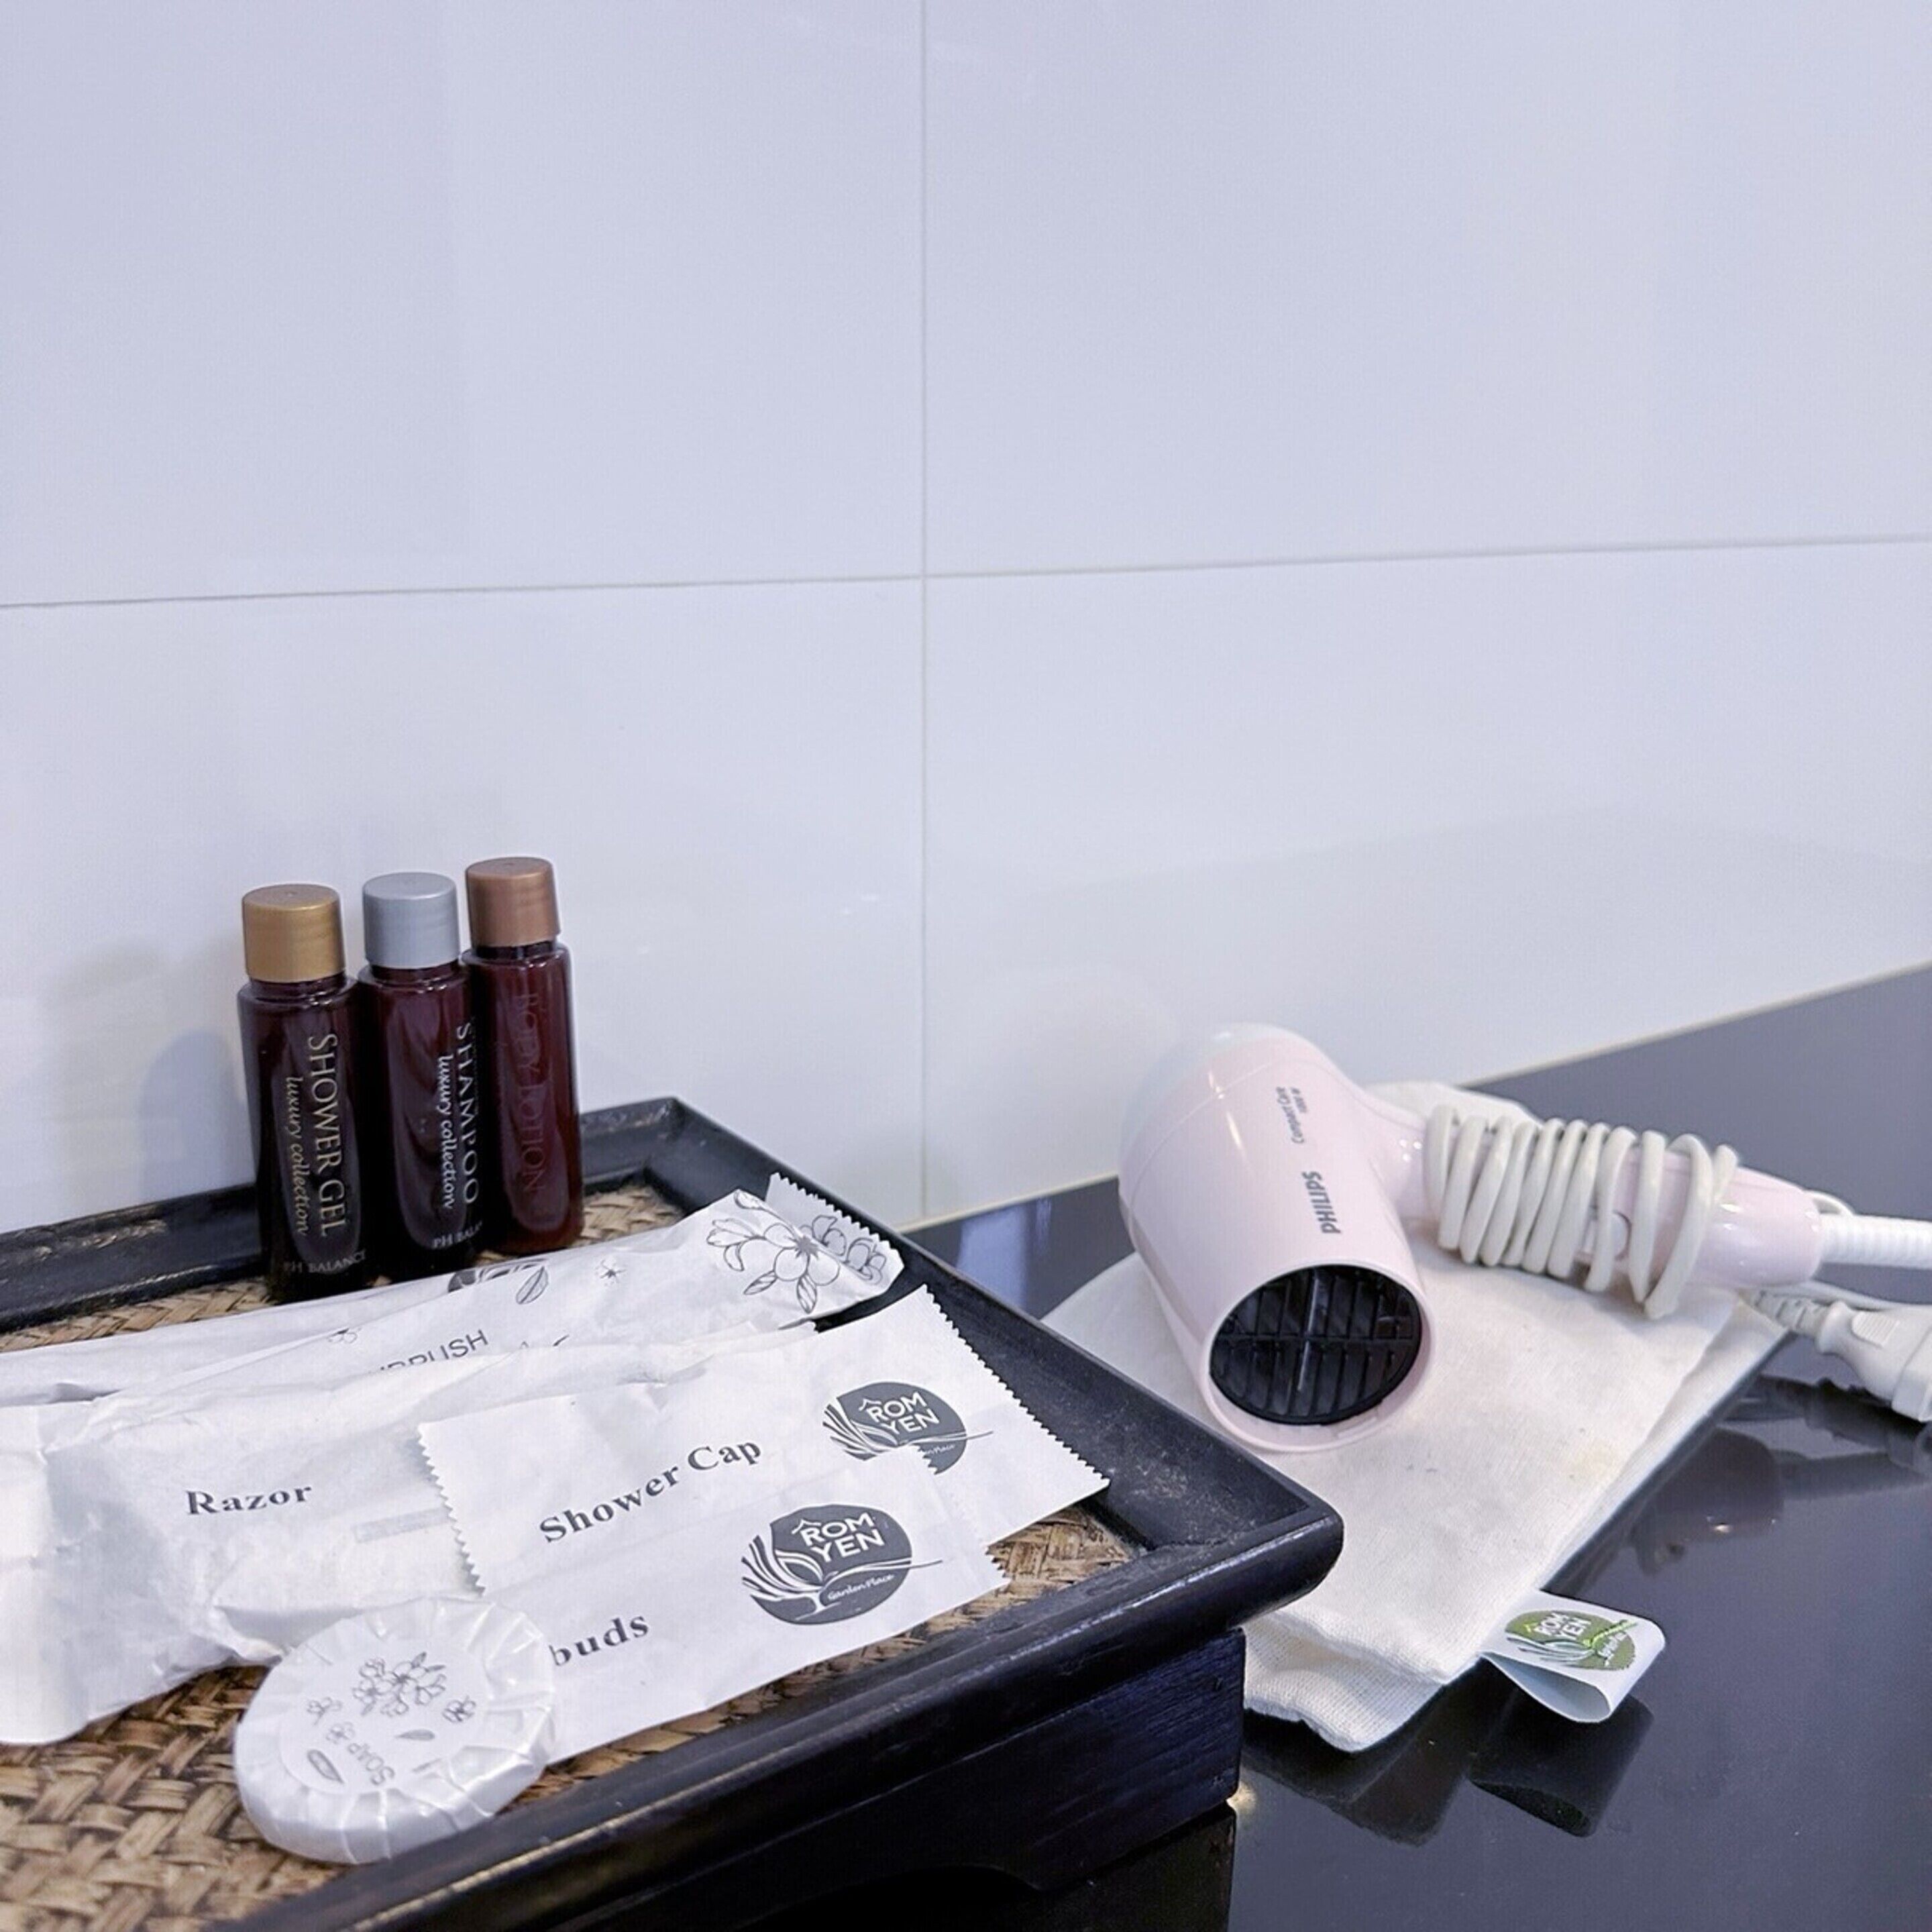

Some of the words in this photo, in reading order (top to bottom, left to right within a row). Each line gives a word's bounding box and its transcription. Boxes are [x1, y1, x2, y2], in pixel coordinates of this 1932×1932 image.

[284, 1075, 303, 1138] luxury
[308, 1033, 343, 1174] SHOWER
[435, 1053, 454, 1116] luxury
[289, 1142, 312, 1238] collection
[440, 1120, 458, 1209] collection
[319, 1179, 349, 1238] GEL
[1301, 1171, 1342, 1234] PHILIPS
[865, 1391, 928, 1424] ROM
[879, 1408, 940, 1435] YEN
[186, 1486, 312, 1515] Razor
[539, 1465, 679, 1544] Shower
[687, 1441, 761, 1471] Cap
[799, 1511, 875, 1547] ROM
[810, 1528, 885, 1563] YEN
[548, 1615, 649, 1667] buds
